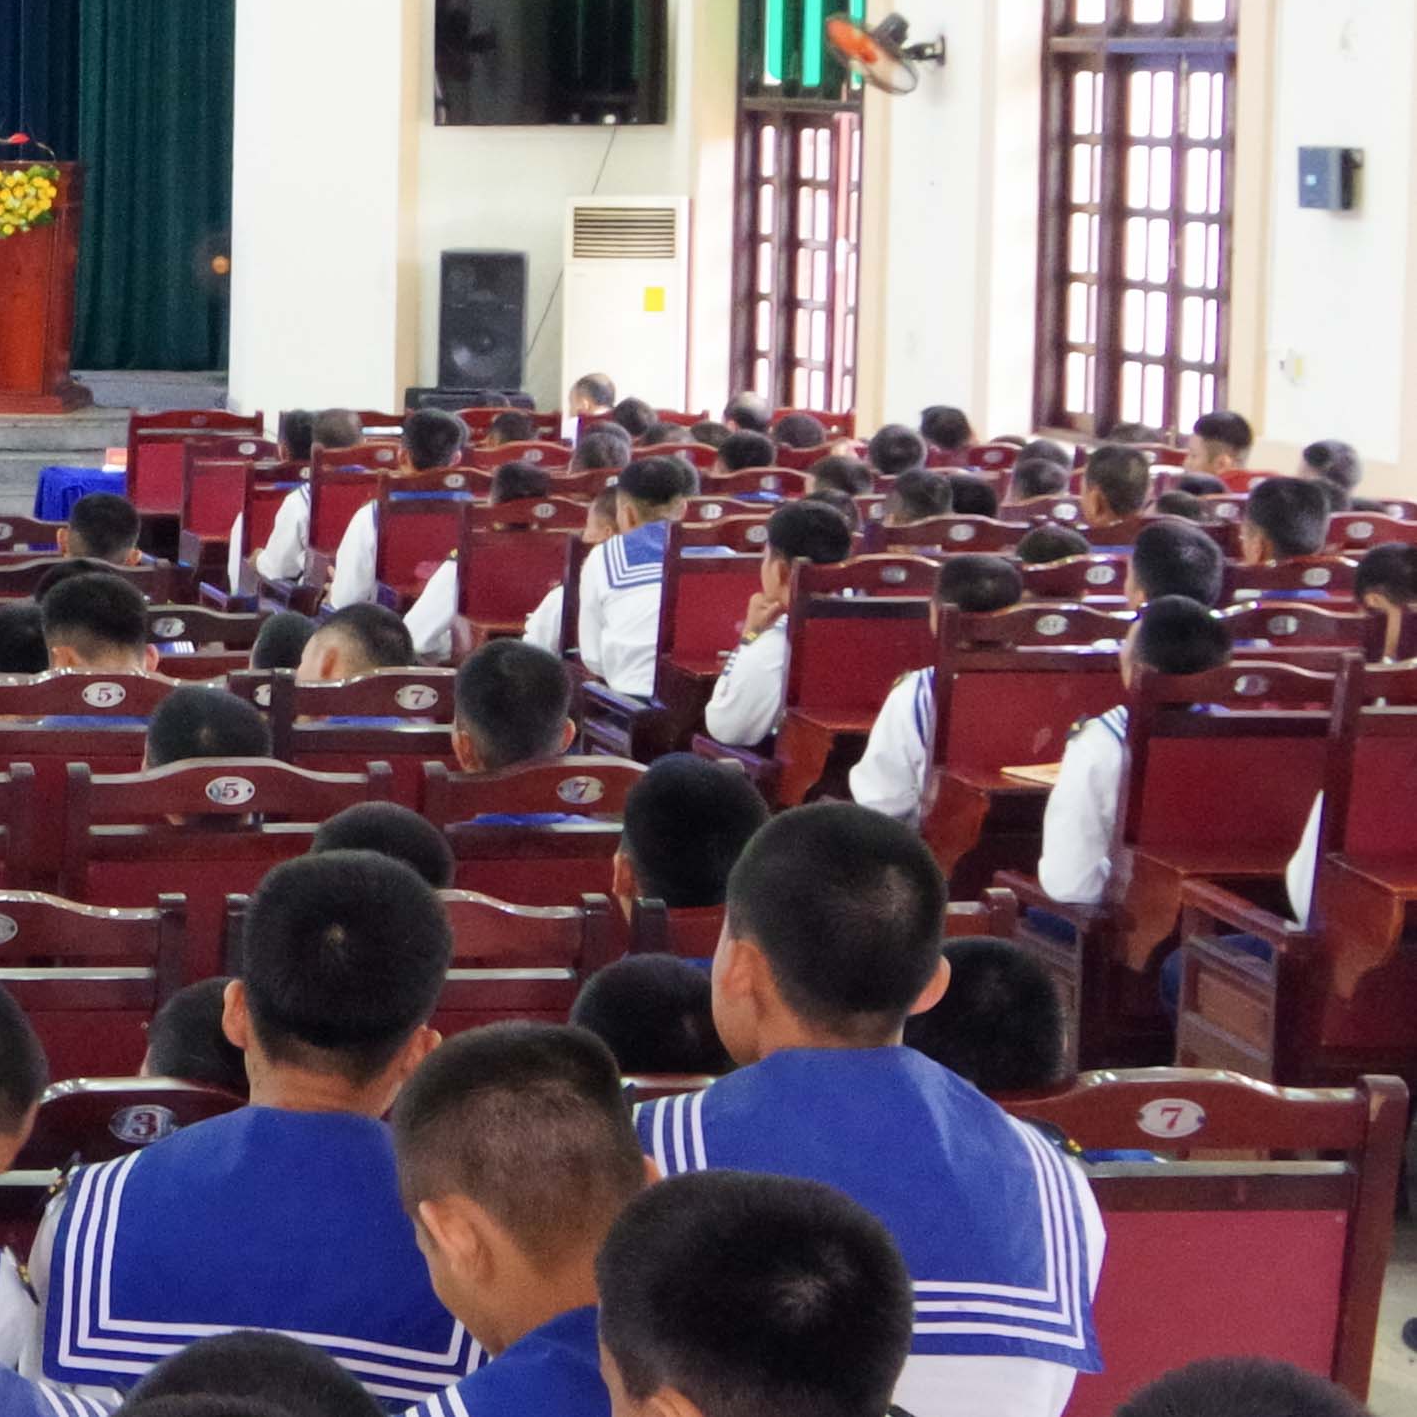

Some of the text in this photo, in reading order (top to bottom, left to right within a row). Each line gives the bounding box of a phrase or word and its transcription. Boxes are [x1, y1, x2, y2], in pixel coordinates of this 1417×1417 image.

[162, 619, 176, 633] 7
[97, 687, 113, 703] 5
[409, 689, 424, 704] 7
[221, 782, 240, 799] 5
[572, 781, 591, 800] 7
[132, 1111, 158, 1137] 3
[1159, 1106, 1184, 1130] 7
